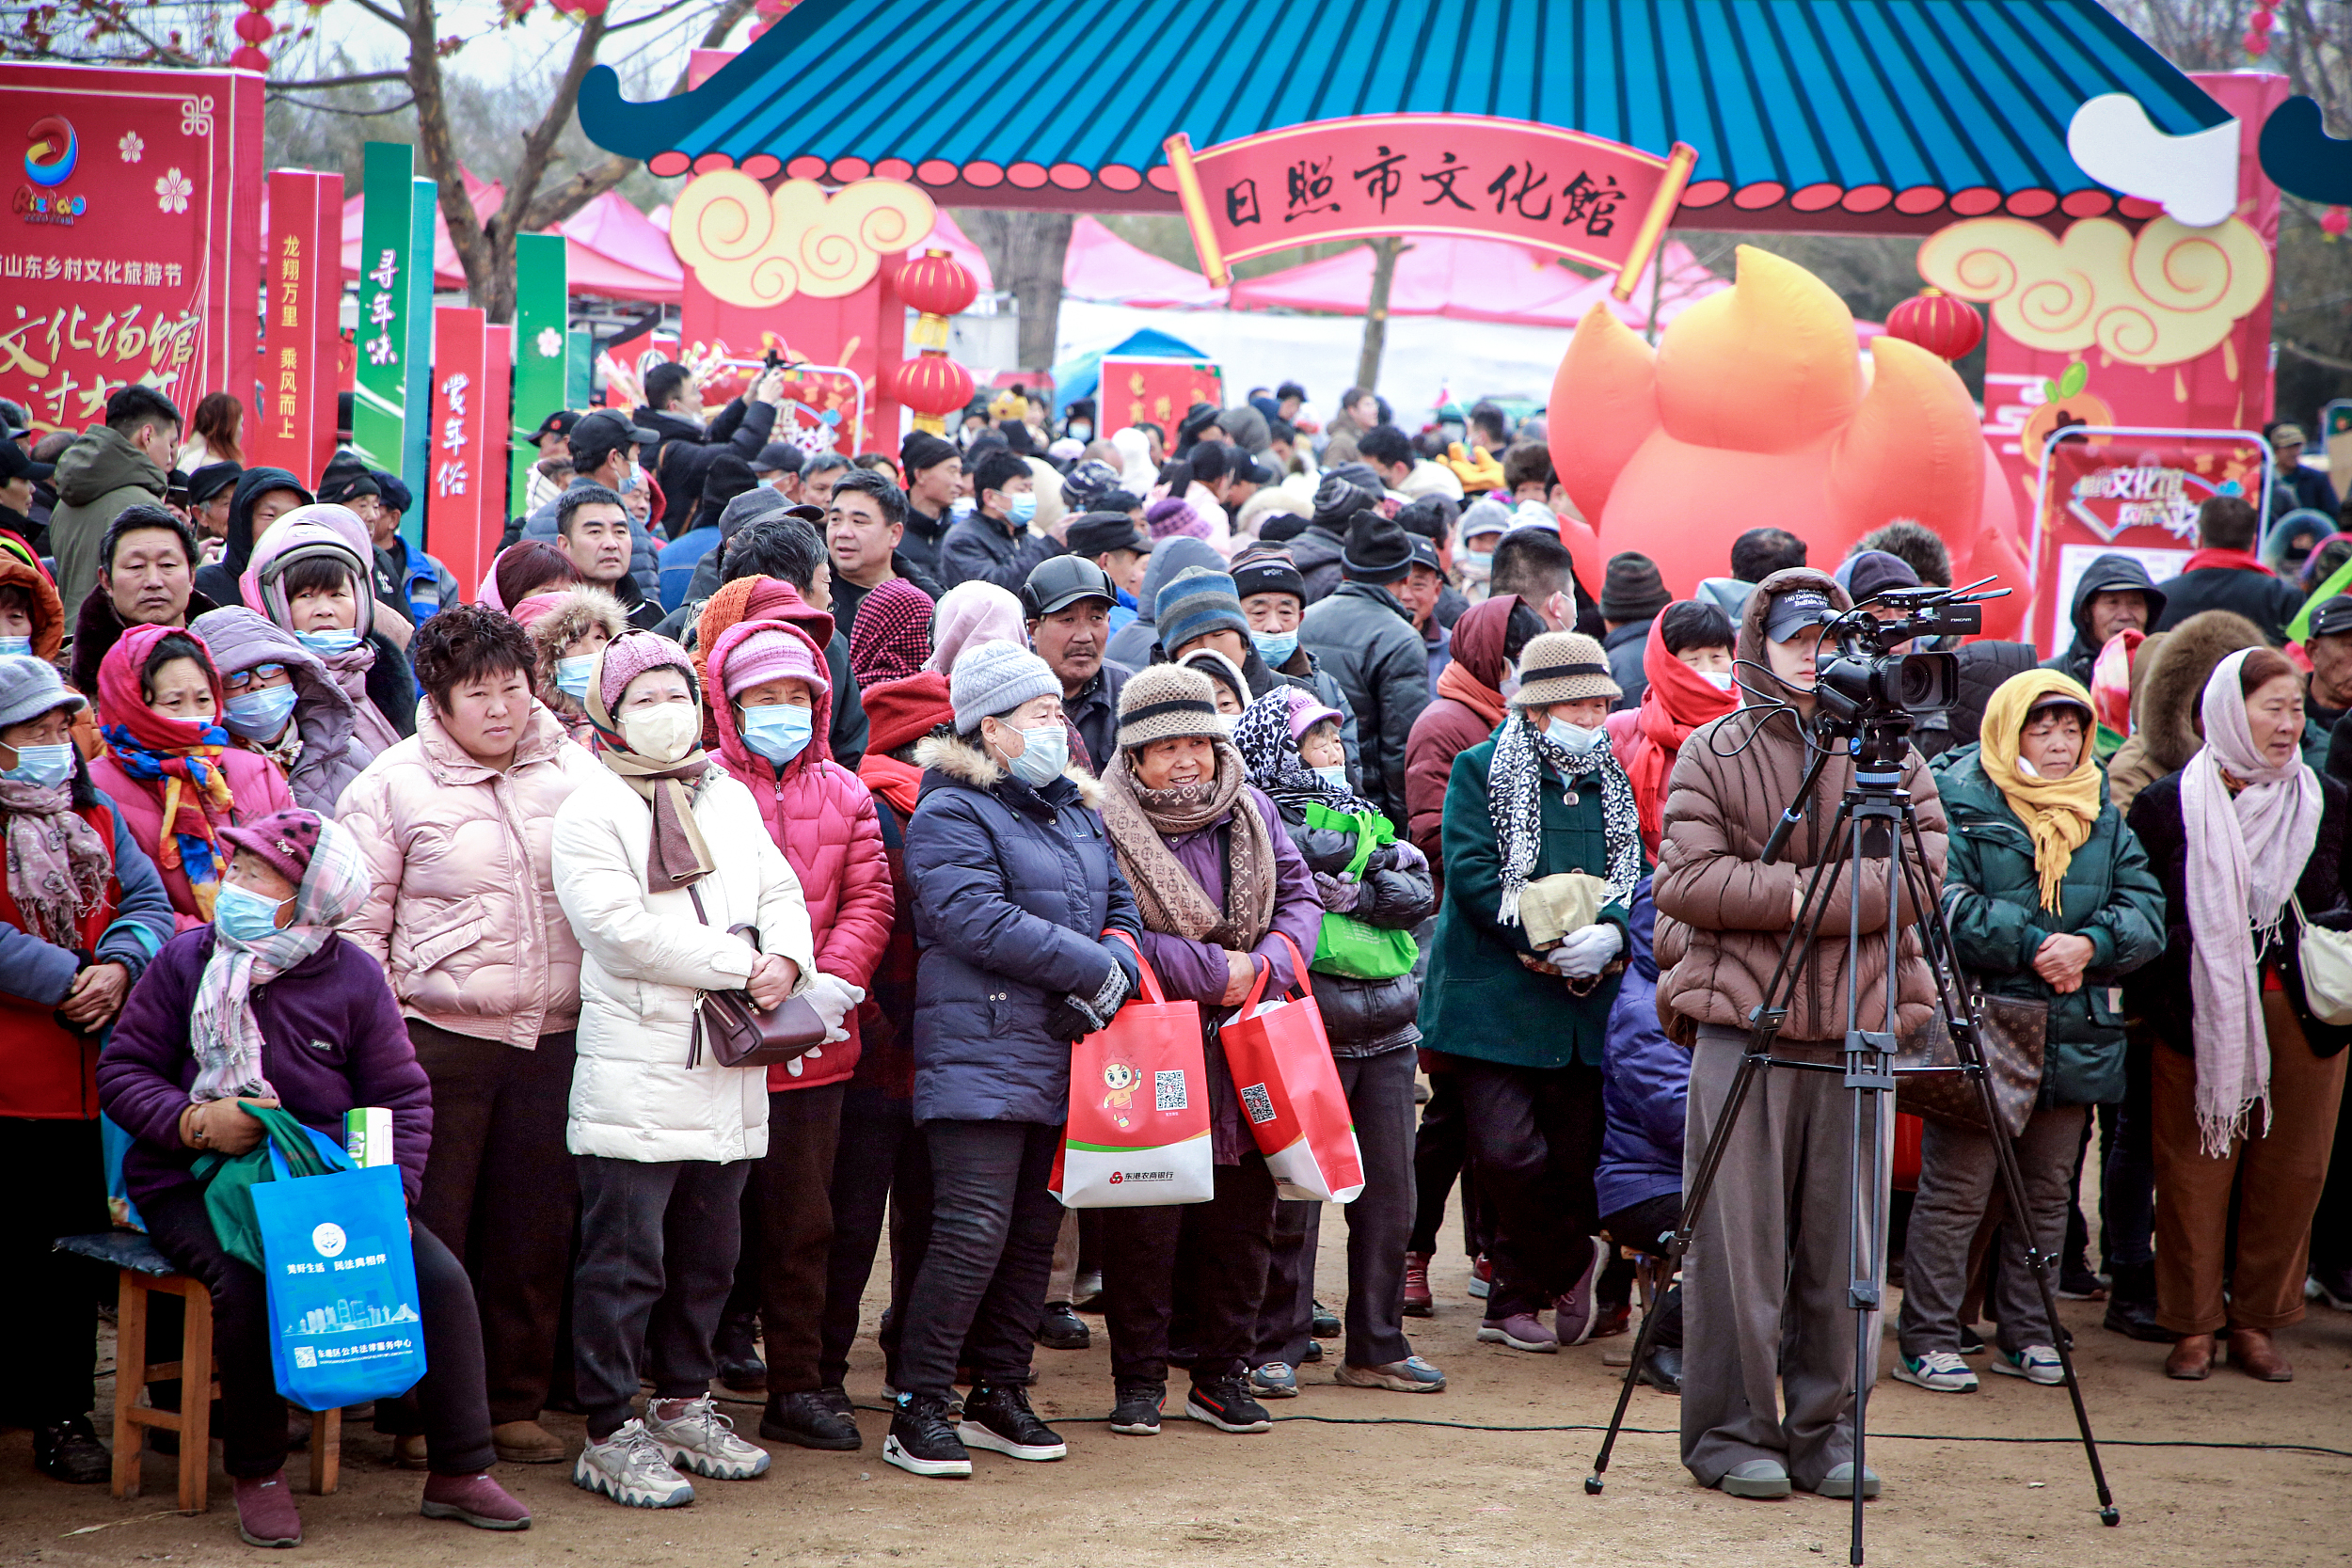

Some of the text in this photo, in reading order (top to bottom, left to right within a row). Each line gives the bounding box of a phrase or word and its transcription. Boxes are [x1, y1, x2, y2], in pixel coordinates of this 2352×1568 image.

[12, 185, 87, 216] Rizhao
[0, 253, 183, 288] 山东乡村文化旅游节
[364, 247, 399, 366] 寻年味
[0, 303, 200, 379] 文化场馆
[278, 234, 300, 439] 龙翔万里 乘风而上
[438, 372, 469, 498] 赏年俗
[286, 1253, 388, 1275] 美好生活 民法典相伴
